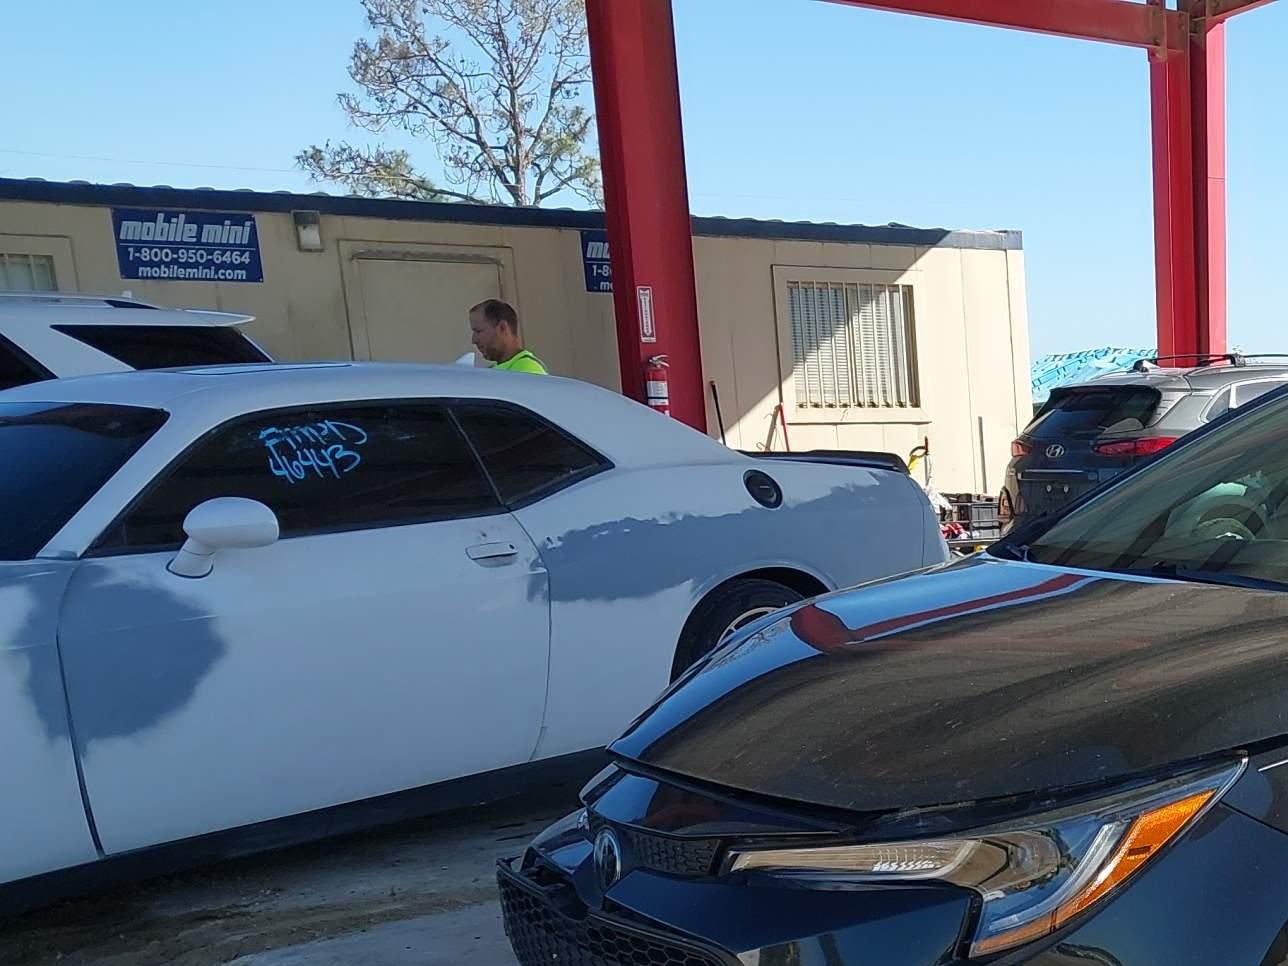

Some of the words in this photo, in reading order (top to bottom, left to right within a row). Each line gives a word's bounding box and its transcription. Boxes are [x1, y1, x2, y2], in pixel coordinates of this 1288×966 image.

[119, 213, 198, 242] mobile
[200, 220, 252, 244] mini
[127, 247, 251, 265] 1-800-950-6464
[137, 264, 247, 280] mobilemini.com
[268, 444, 361, 484] 46443
